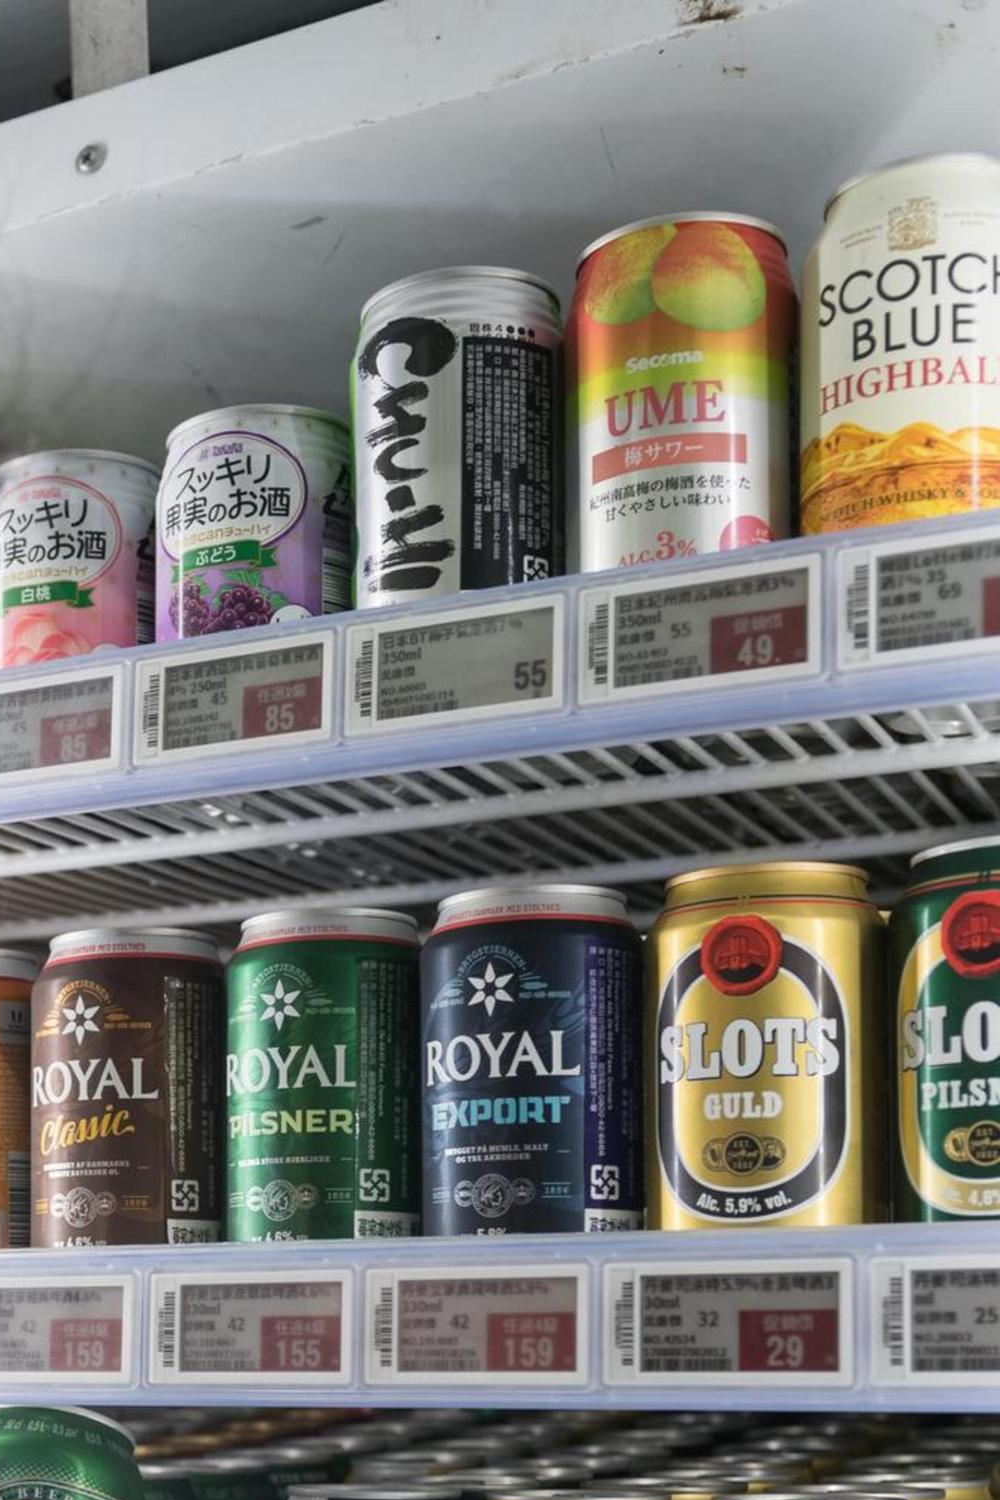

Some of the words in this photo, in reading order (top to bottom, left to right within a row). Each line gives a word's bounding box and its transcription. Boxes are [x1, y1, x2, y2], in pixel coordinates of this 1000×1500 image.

[820, 252, 1000, 326] SCOTC
[853, 302, 977, 362] BLUE
[625, 349, 704, 374] Secoma
[819, 355, 1000, 418] HIGHBAL
[604, 379, 726, 437] UME
[624, 440, 704, 470] 梅サワー
[176, 453, 270, 500] スッキリ
[165, 486, 291, 538] 果実のお酒
[605, 491, 732, 523] 甘くやさしい味わい
[196, 545, 236, 566] ぶどう
[21, 585, 51, 604] 白桃
[618, 611, 662, 629] 350ml
[670, 622, 692, 639] 55
[381, 648, 422, 664] 350ml
[738, 634, 774, 666] 49
[514, 659, 548, 690] 55
[264, 705, 295, 732] 85
[60, 734, 88, 758] 85
[660, 1016, 840, 1085] SLOTS
[902, 1000, 1000, 1071] SLO
[226, 1044, 357, 1097] ROYAL
[426, 1030, 581, 1087] ROYAL
[33, 1057, 159, 1107] ROYAL
[921, 1077, 1000, 1111] PILS
[432, 1096, 570, 1131] EXPORT
[703, 1090, 783, 1121] GULD
[40, 1104, 135, 1156] Classic
[230, 1109, 354, 1139] PILSNER
[696, 1191, 721, 1213] Alc.
[725, 1194, 762, 1214] 5,9%
[765, 1190, 793, 1207] vol.
[697, 1311, 720, 1328] 32
[973, 1307, 1000, 1325] 25
[64, 1340, 103, 1368] 159
[276, 1340, 321, 1368] 155
[505, 1336, 555, 1368] 159
[767, 1334, 804, 1367] 29
